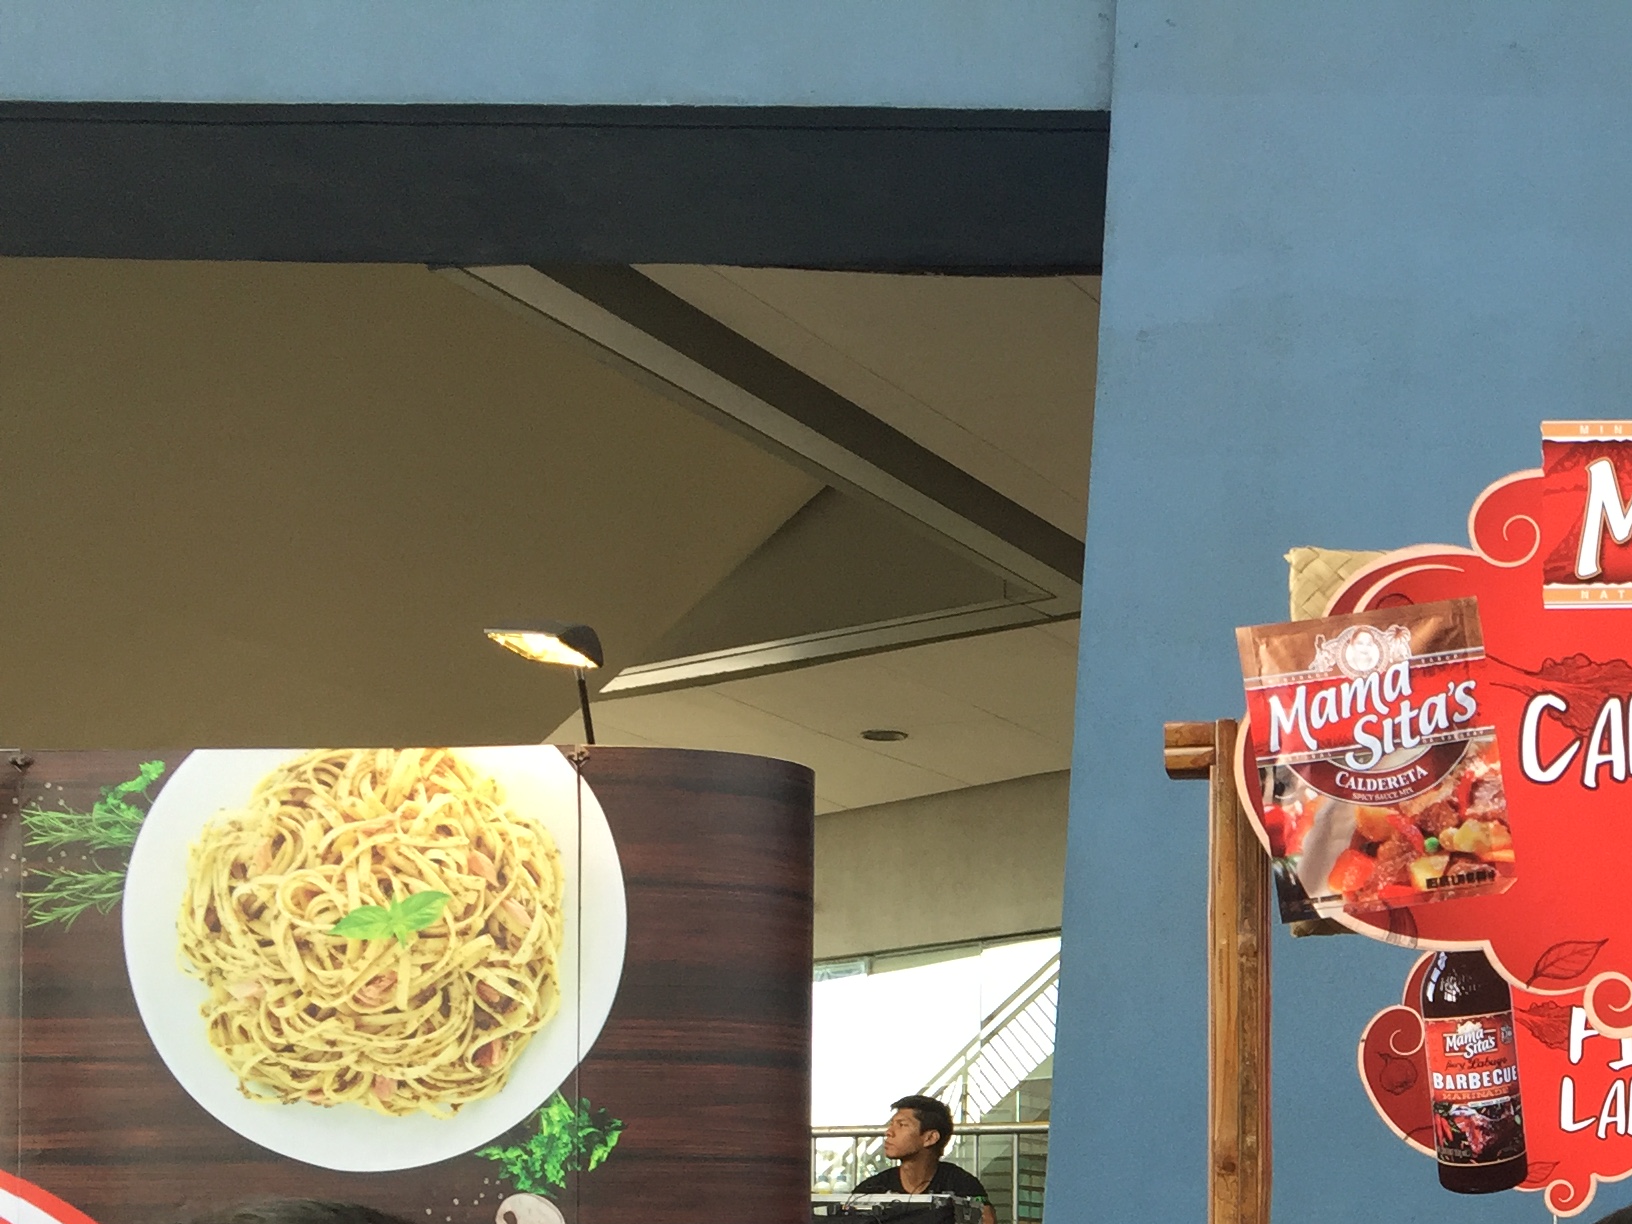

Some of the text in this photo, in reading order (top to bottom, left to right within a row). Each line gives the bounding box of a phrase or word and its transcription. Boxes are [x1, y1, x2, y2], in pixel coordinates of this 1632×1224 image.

[1269, 660, 1413, 752] Mama
[1345, 680, 1477, 771] Sita's
[1335, 765, 1429, 792] CALDERETA
[1445, 1028, 1485, 1052] Mama
[1463, 1035, 1497, 1059] Sita's
[1432, 1065, 1517, 1090] BARBECUE
[1442, 1086, 1510, 1101] MARINADE
